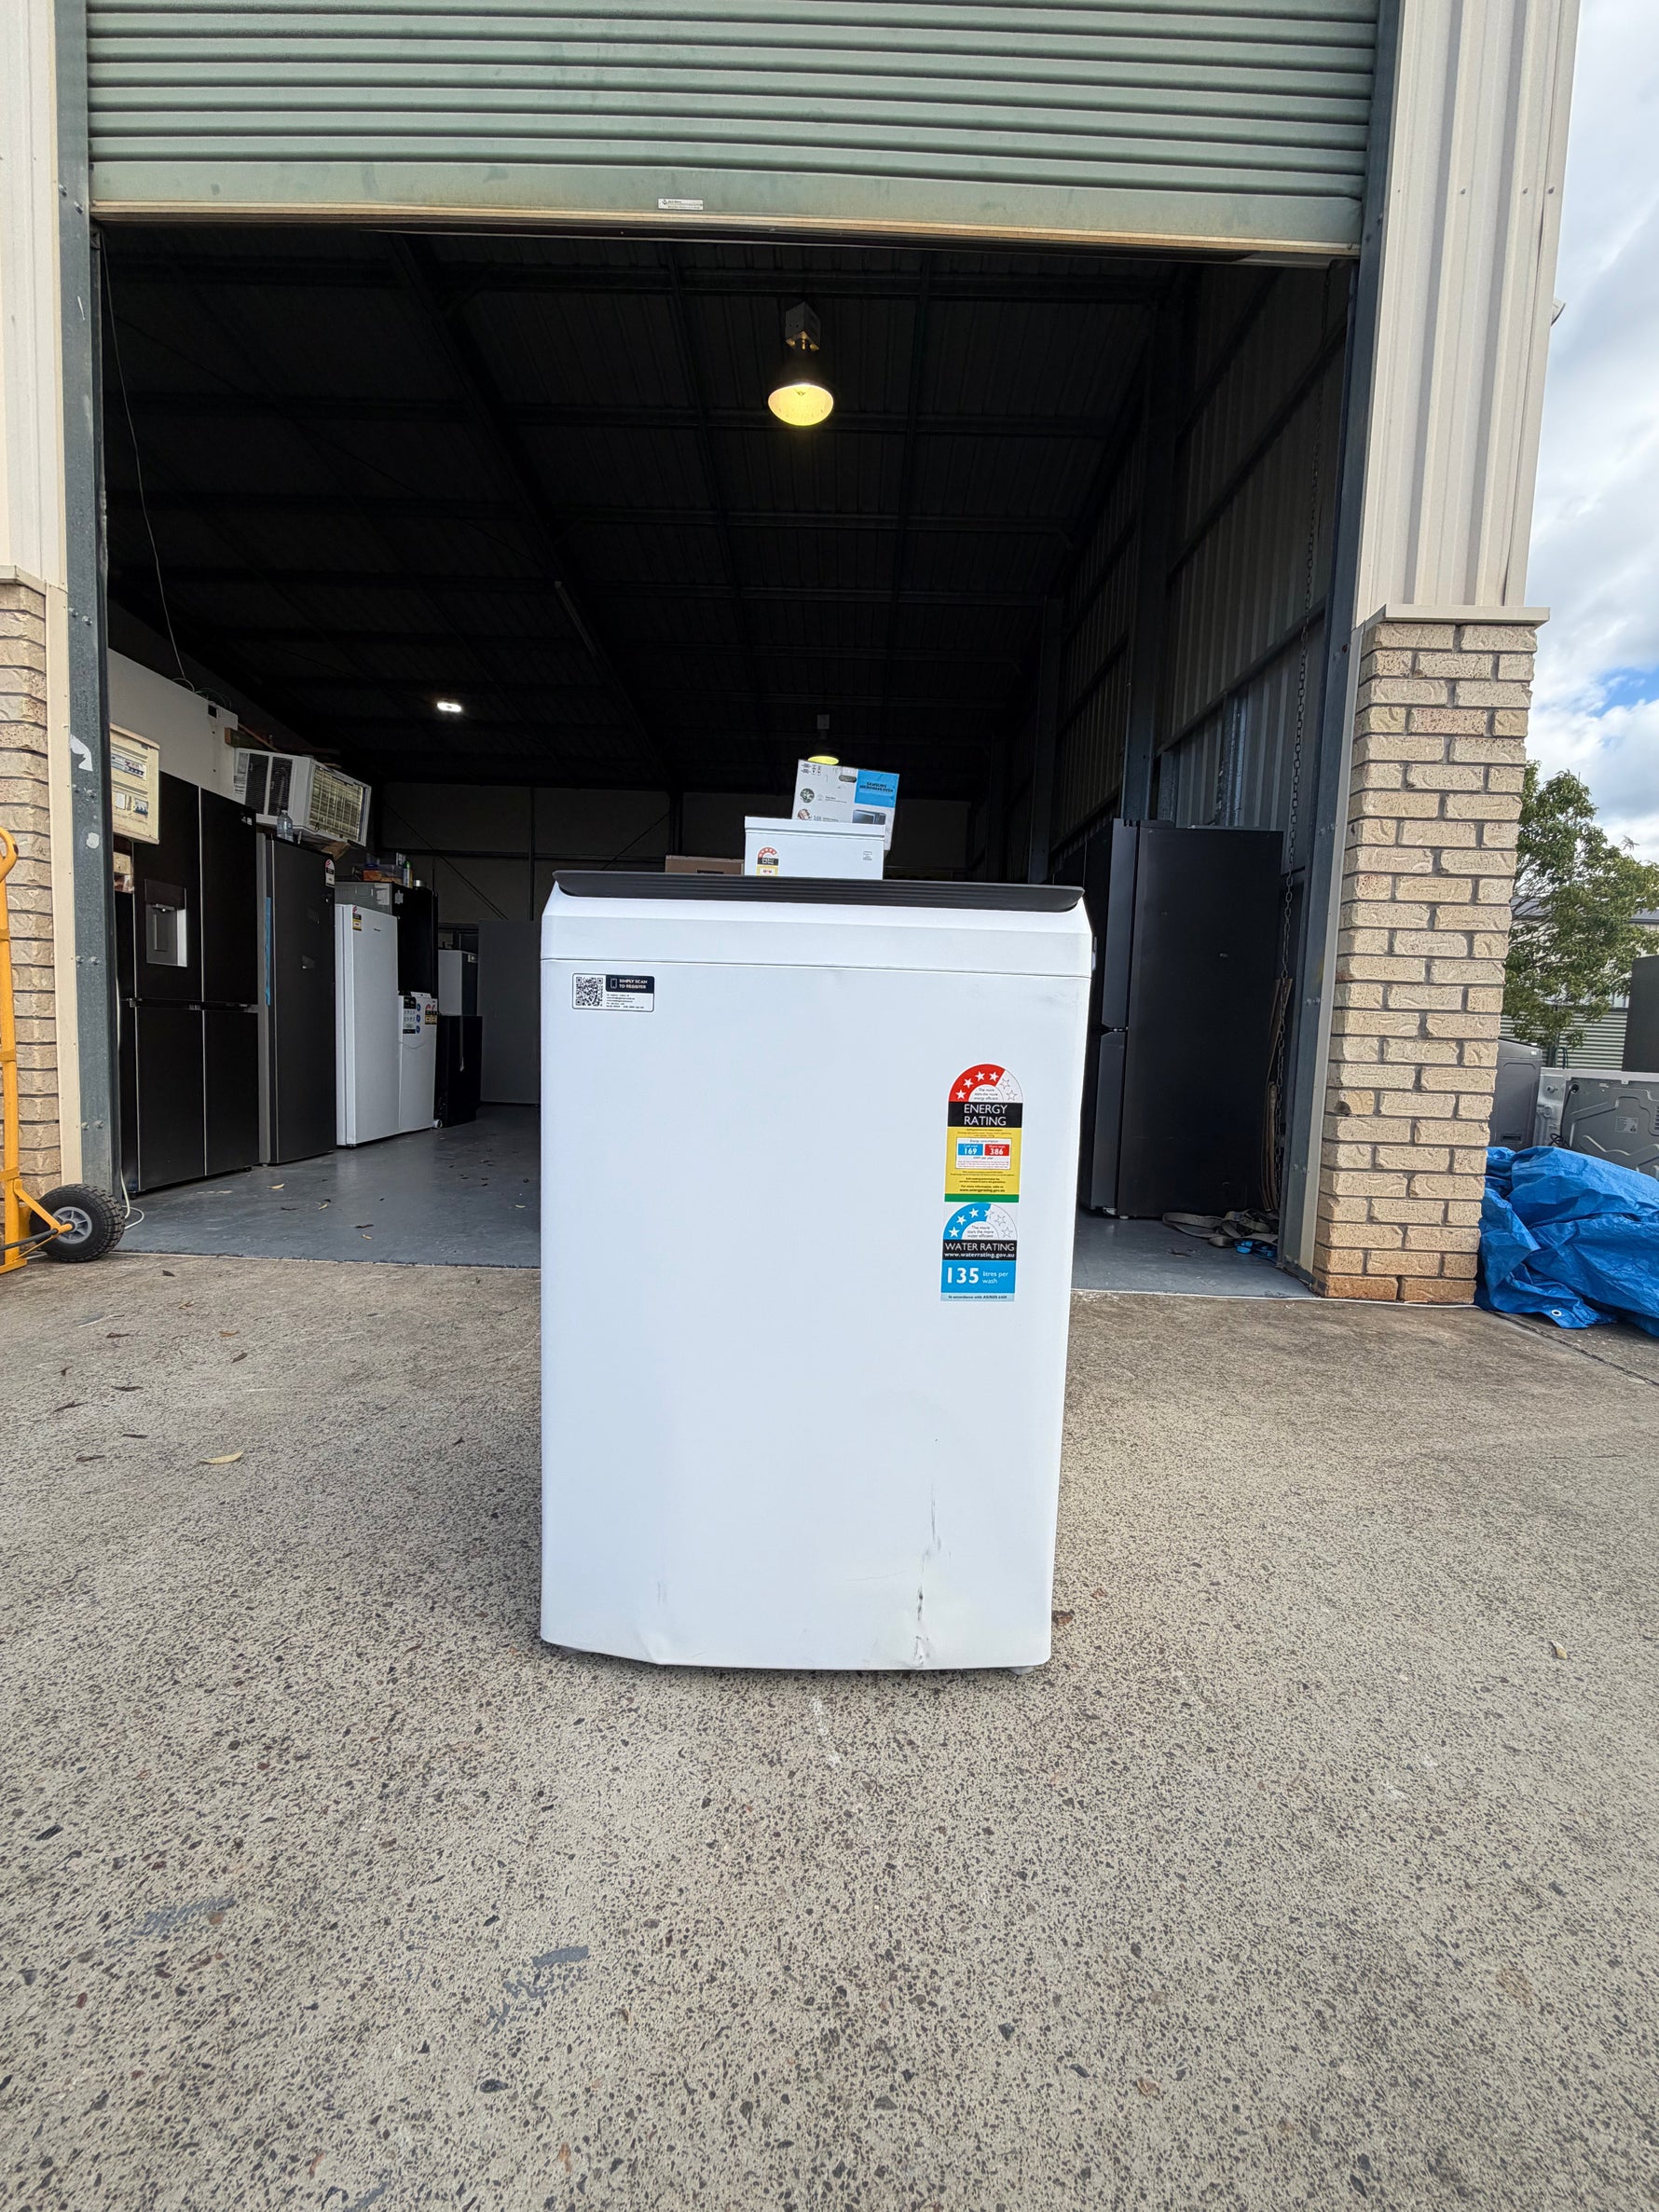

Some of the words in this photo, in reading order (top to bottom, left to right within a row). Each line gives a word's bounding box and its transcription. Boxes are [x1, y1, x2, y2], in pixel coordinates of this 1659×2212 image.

[964, 1104, 1008, 1114] ENERGY
[964, 1116, 1007, 1125] RATING
[944, 1243, 979, 1251] WATER
[980, 1243, 1015, 1251] RATING
[947, 1267, 980, 1284] 135
